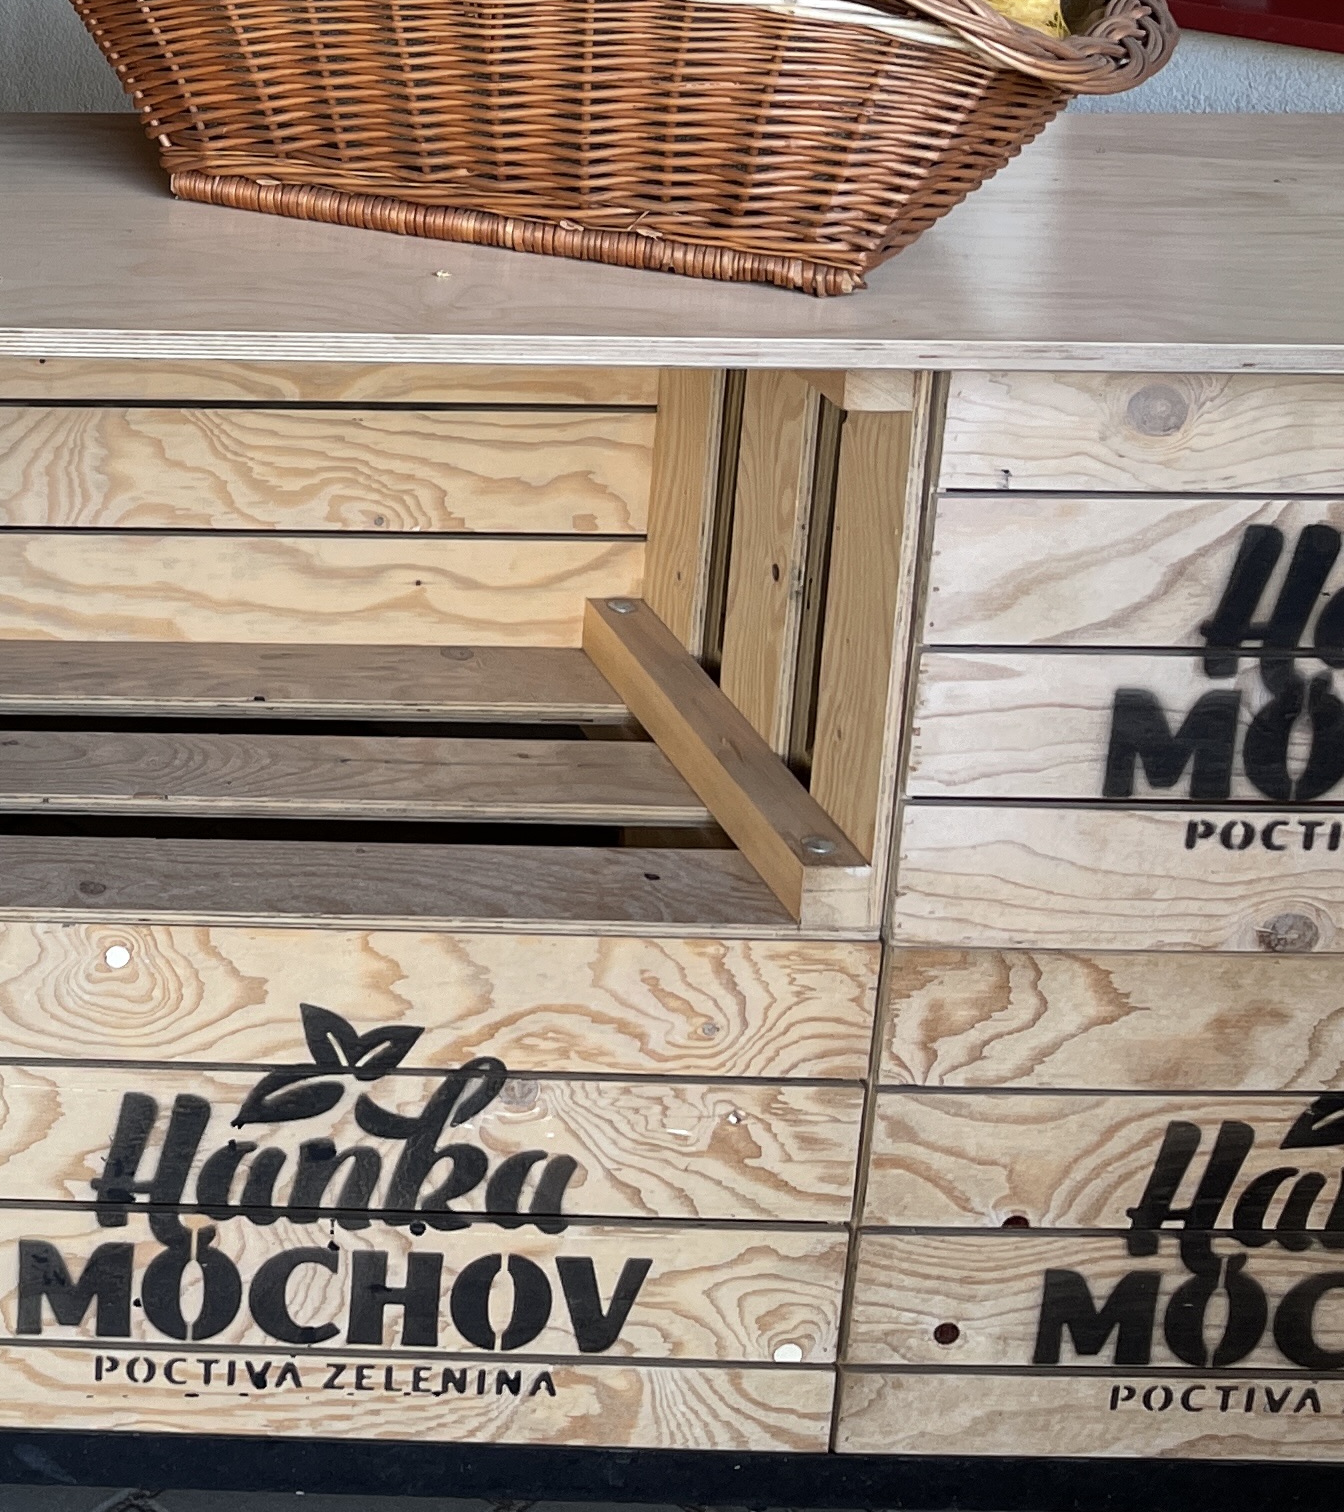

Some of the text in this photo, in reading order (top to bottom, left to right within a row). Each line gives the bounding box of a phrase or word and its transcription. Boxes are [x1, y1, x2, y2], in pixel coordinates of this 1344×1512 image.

[1185, 819, 1344, 851] POCTI
[90, 1056, 578, 1249] Hanka
[16, 1239, 653, 1353] MOCHOV
[1033, 1267, 1344, 1369] MOC
[323, 1362, 557, 1397] ZELENINA
